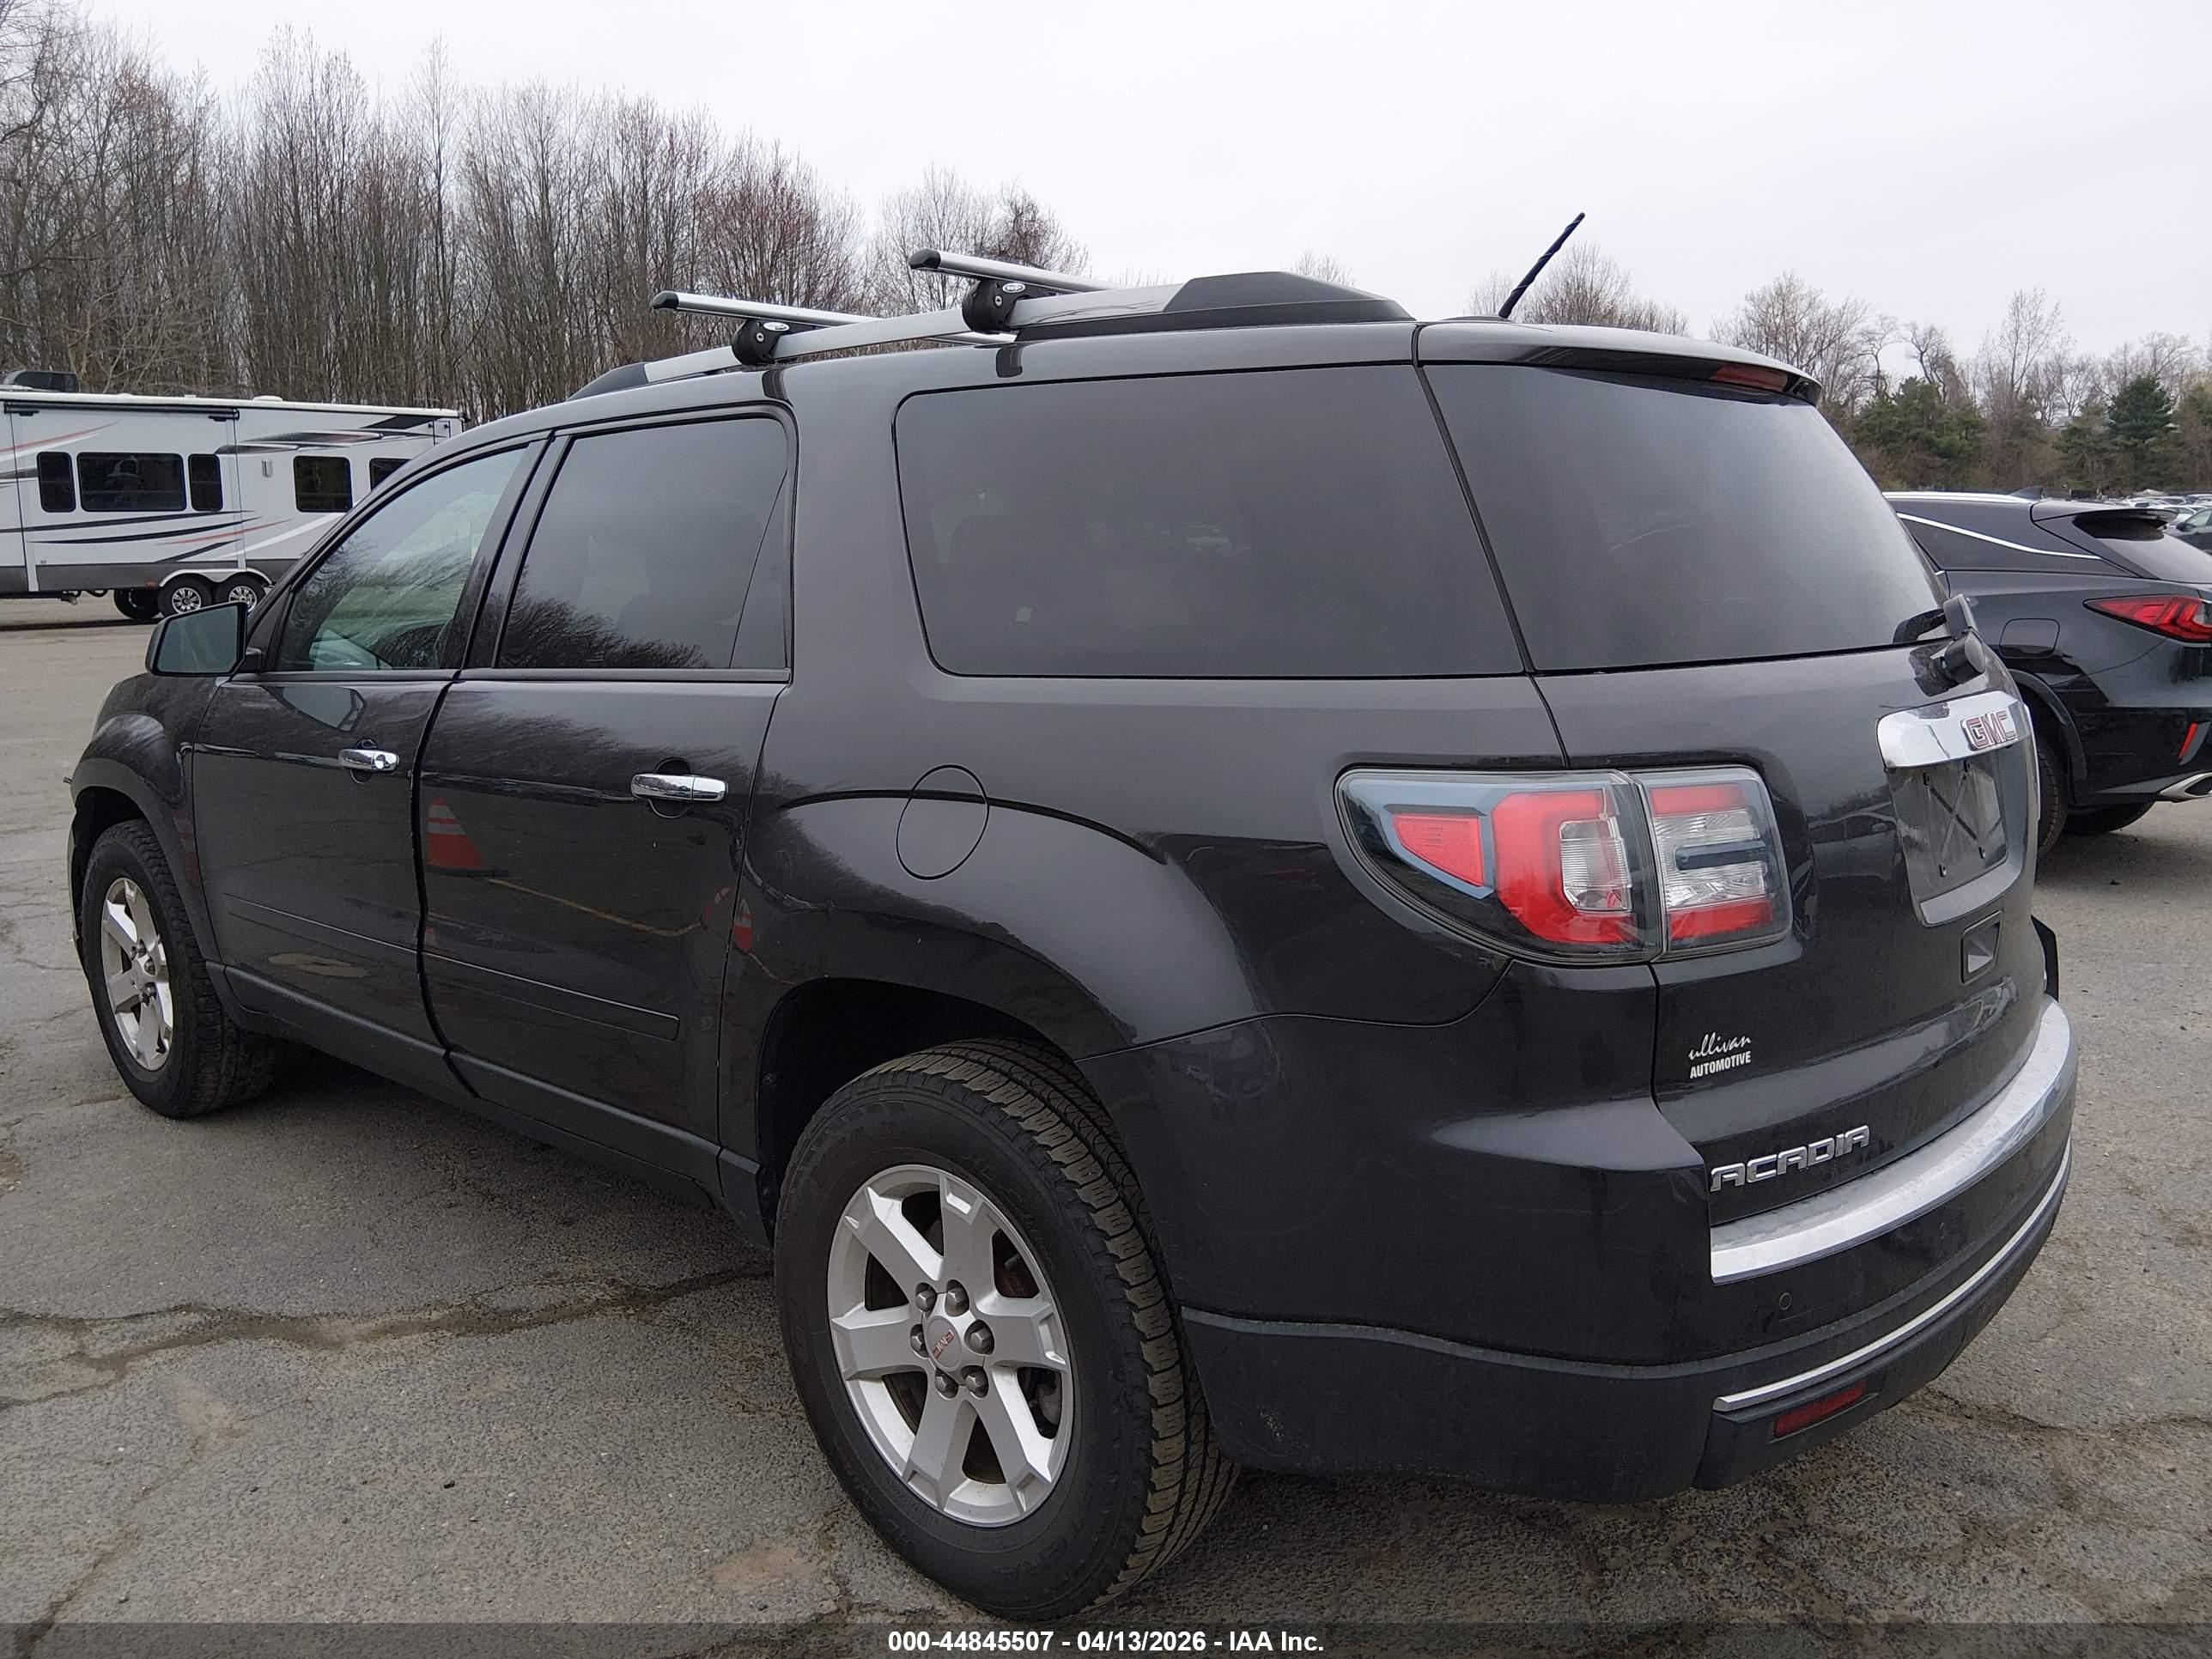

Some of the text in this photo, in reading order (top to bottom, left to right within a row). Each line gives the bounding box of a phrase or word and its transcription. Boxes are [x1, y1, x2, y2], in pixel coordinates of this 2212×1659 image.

[1960, 710, 2017, 750] GMC
[1689, 1050, 1752, 1079] AUTOMOTIVE
[1710, 1125, 1870, 1192] ACADIA
[933, 1329, 955, 1359] GMC
